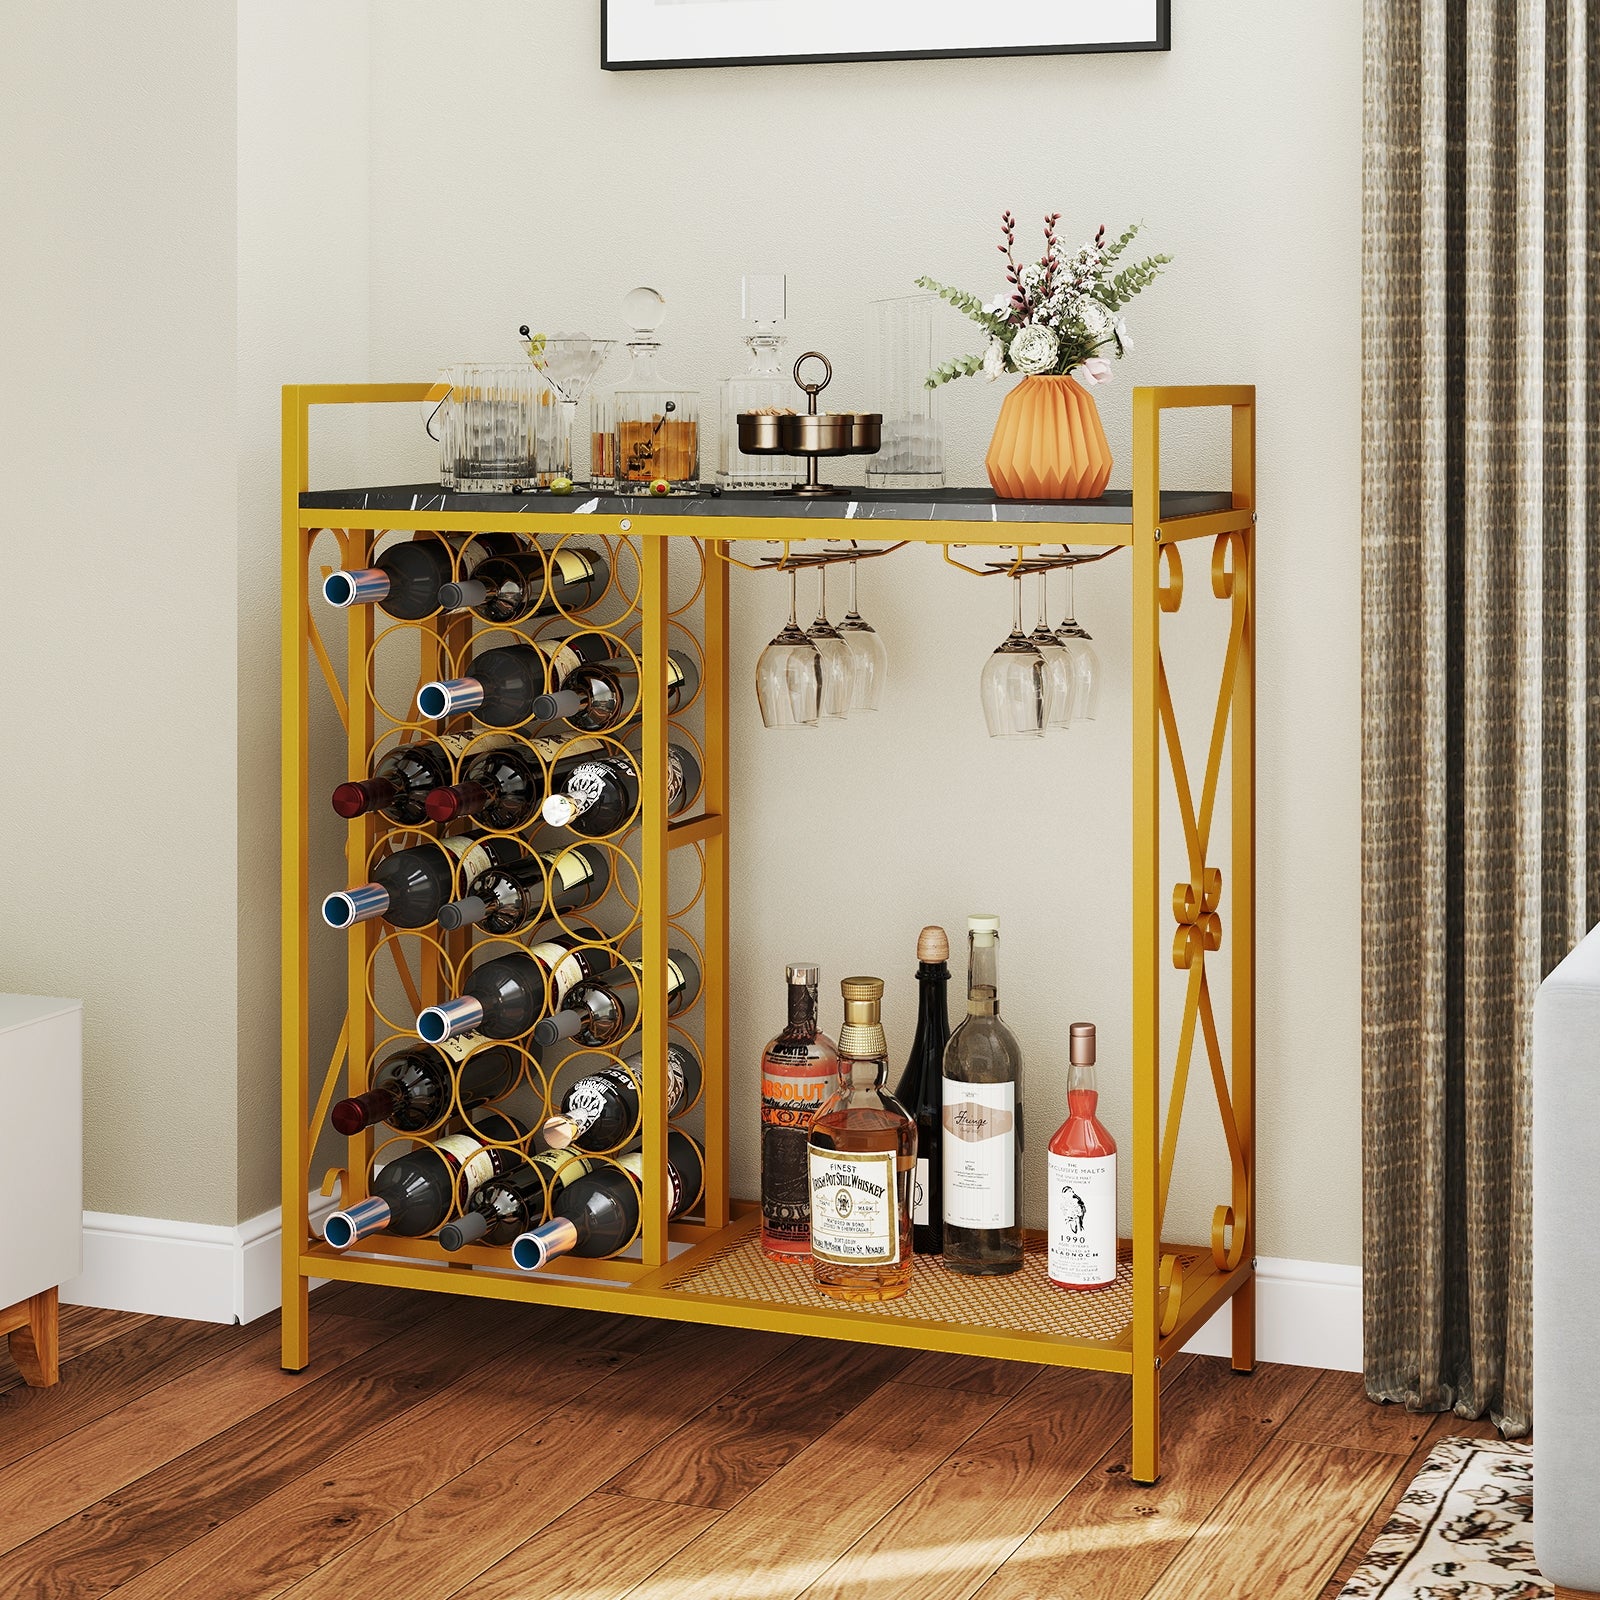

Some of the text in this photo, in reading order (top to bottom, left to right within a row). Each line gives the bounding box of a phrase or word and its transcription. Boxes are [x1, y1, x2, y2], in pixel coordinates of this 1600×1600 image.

[772, 1044, 809, 1057] PORTED
[830, 1163, 857, 1174] FINEST
[836, 1172, 851, 1187] STILL
[851, 1174, 886, 1199] WHISKEY
[768, 1219, 810, 1233] PORTED
[1060, 1234, 1086, 1244] 1990
[1051, 1247, 1099, 1258] BLADNOCH
